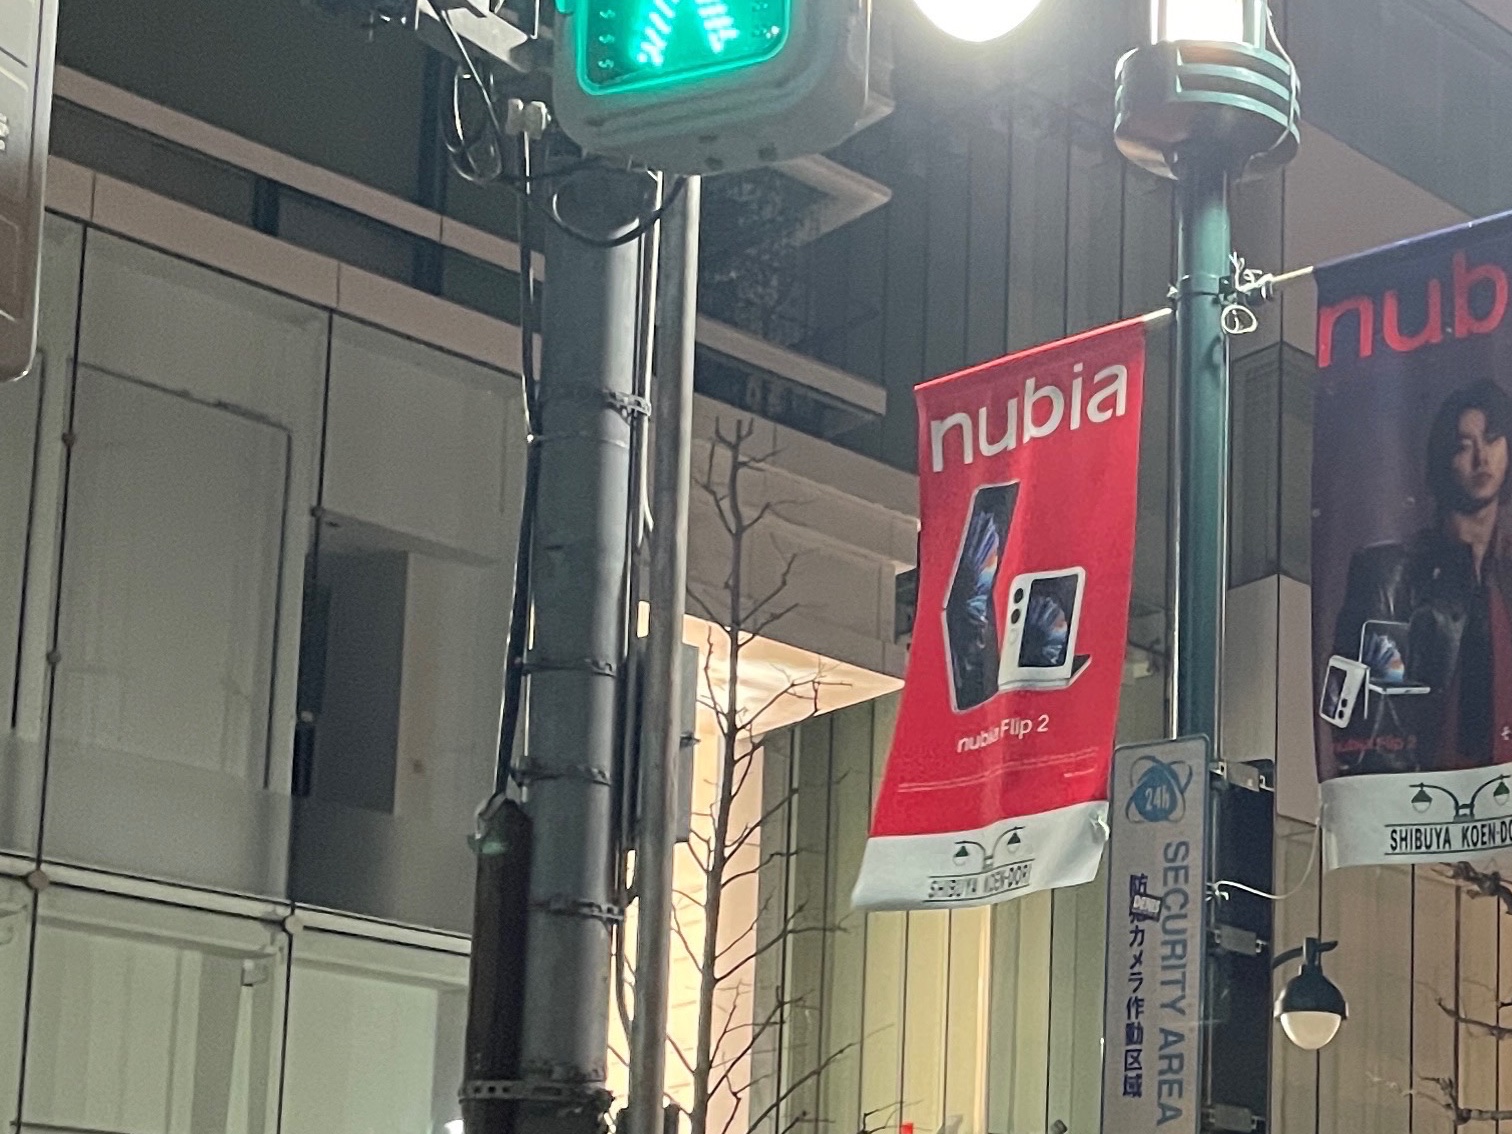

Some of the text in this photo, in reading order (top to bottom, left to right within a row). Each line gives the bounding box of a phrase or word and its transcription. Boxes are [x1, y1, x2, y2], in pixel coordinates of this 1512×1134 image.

[930, 362, 1128, 473] nubia
[999, 717, 1032, 739] Flip
[1036, 714, 1050, 732] 2
[1145, 787, 1171, 811] 24h
[1390, 824, 1451, 851] SHIBUYA
[1123, 873, 1149, 1099] 防カメラ作動区域
[1156, 840, 1190, 1127] SECURITY AREA
